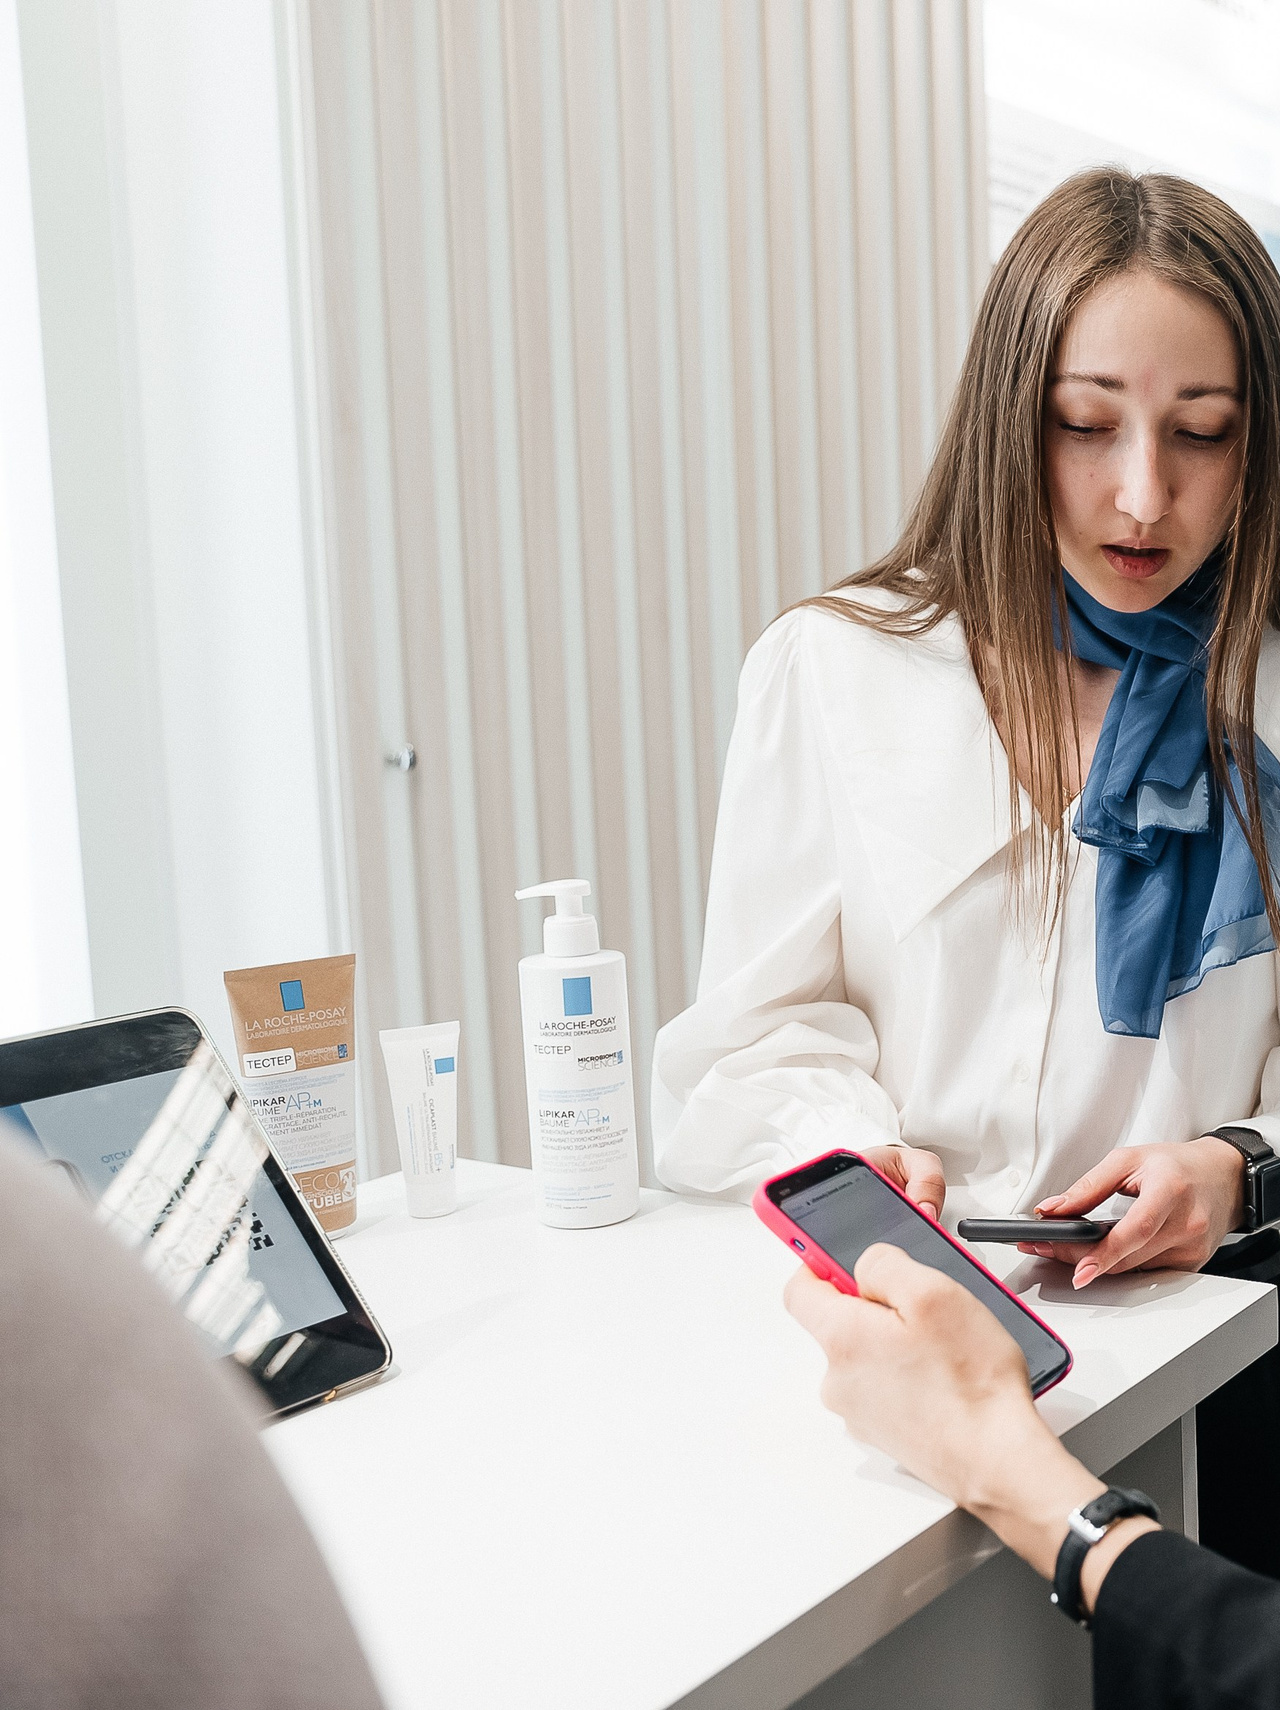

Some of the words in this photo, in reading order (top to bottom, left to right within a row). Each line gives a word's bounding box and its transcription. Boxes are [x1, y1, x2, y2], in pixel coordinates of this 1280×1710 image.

[245, 1020, 261, 1032] LA
[264, 1006, 347, 1028] ROCHE-POSAY
[540, 1022, 550, 1030] LA
[551, 1016, 616, 1030] ROCHE-POSAY
[246, 1026, 290, 1040] LABORATOIRE
[534, 1045, 571, 1054] ТЕСТЕР
[247, 1055, 292, 1069] ТЕСТЕР
[577, 1051, 617, 1063] MICROBIOME
[578, 1058, 618, 1072] SCIENCE
[250, 1096, 286, 1107] IPIKAR
[257, 1106, 281, 1117] UME
[539, 1109, 575, 1118] LIPIKAR
[540, 1118, 570, 1127] BAUME
[300, 1171, 340, 1193] ECO
